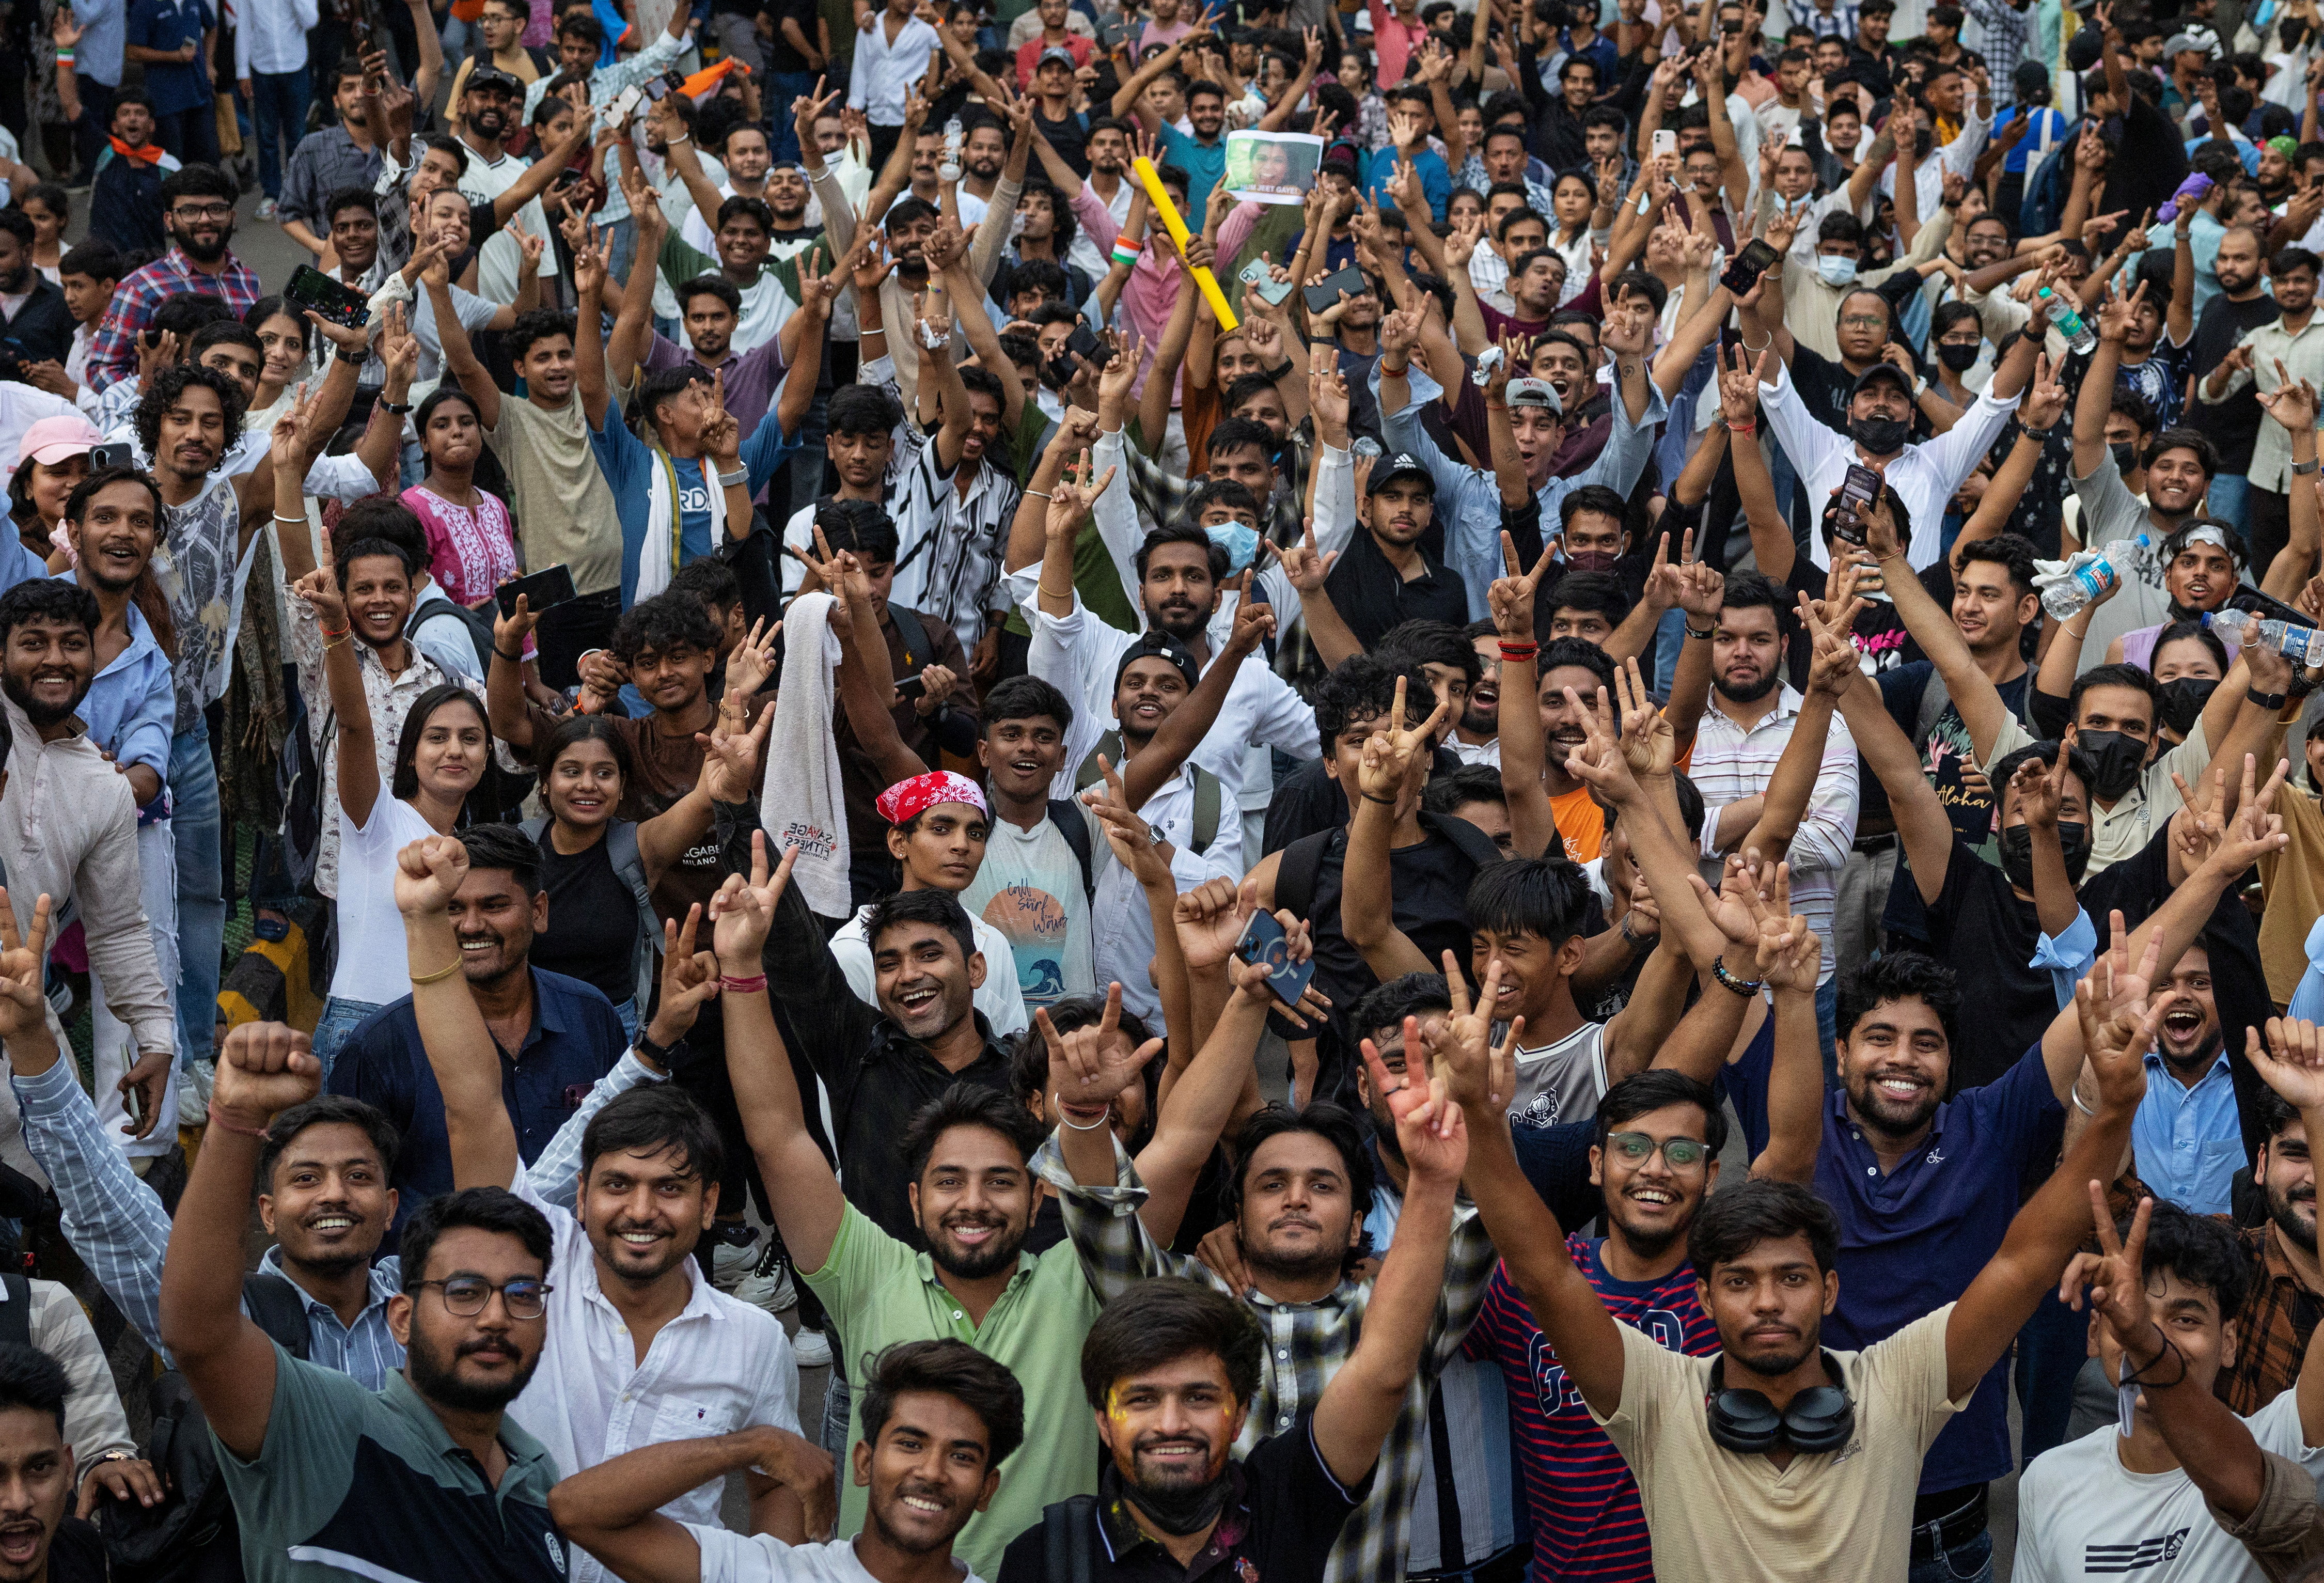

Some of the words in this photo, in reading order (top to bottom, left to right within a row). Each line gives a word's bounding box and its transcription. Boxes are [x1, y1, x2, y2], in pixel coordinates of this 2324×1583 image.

[1936, 785, 1991, 808] Aloha
[682, 856, 716, 866] MILANO
[1018, 895, 1048, 921] Surf
[1033, 914, 1069, 933] Waves
[1529, 1310, 1683, 1417] GP
